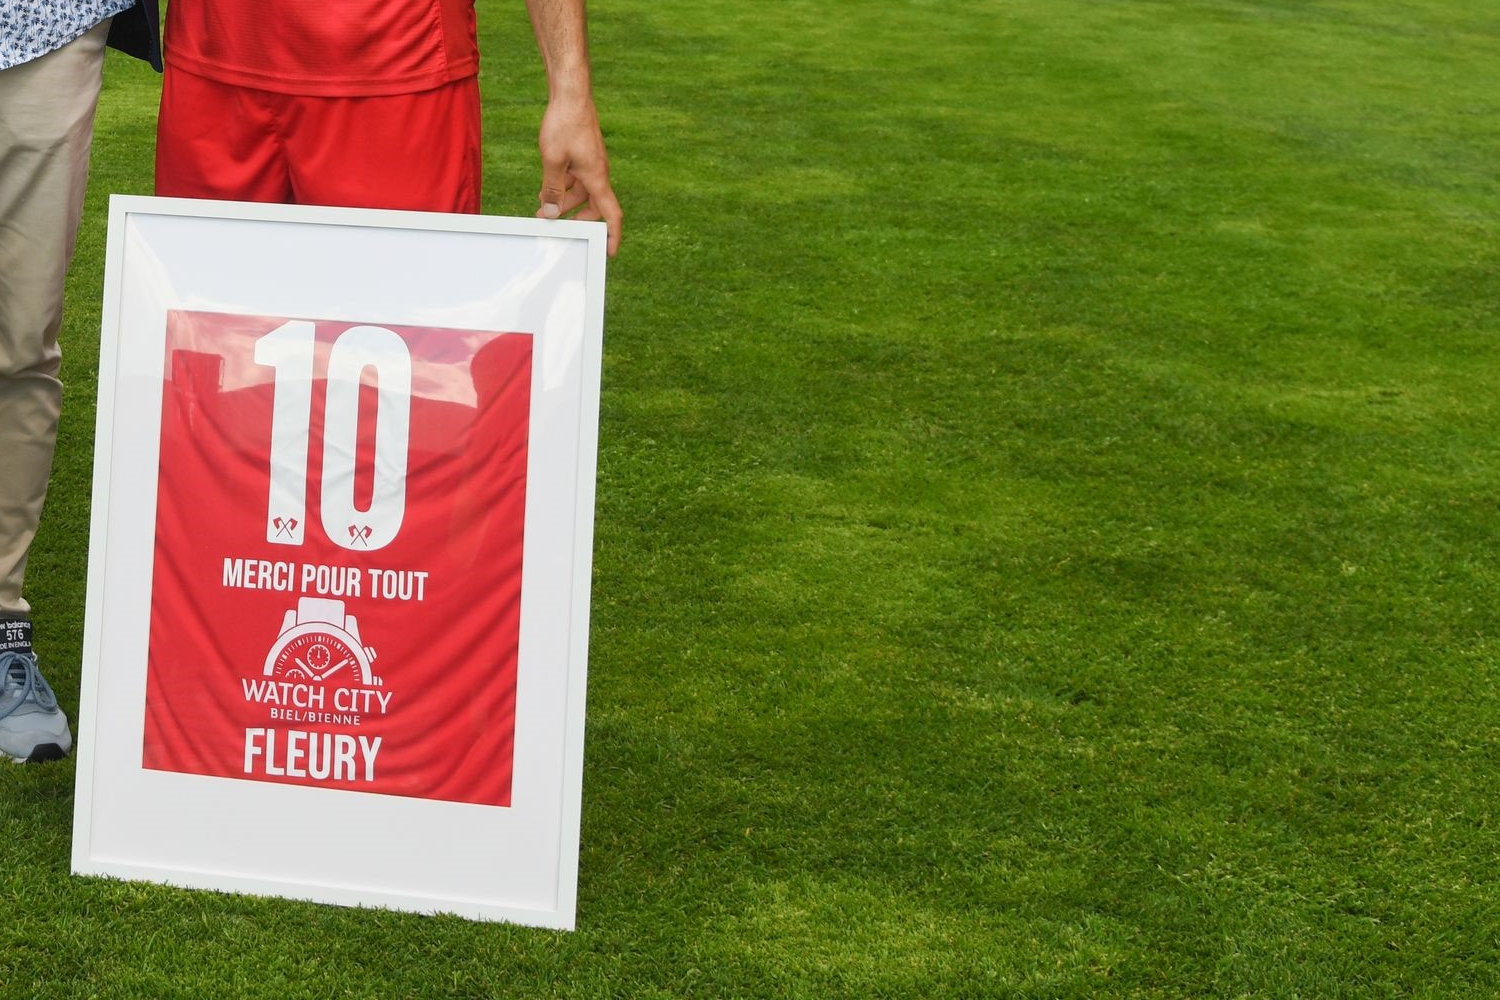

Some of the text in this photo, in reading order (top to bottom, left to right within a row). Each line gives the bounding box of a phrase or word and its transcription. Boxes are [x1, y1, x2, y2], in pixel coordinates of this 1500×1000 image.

[254, 320, 413, 552] 10
[222, 557, 429, 601] MERCI POUR TOUT
[6, 629, 24, 641] 576
[242, 678, 393, 714] WATCH CITY
[270, 707, 361, 726] BIEL/BIENNE
[243, 727, 383, 782] FLEURY
